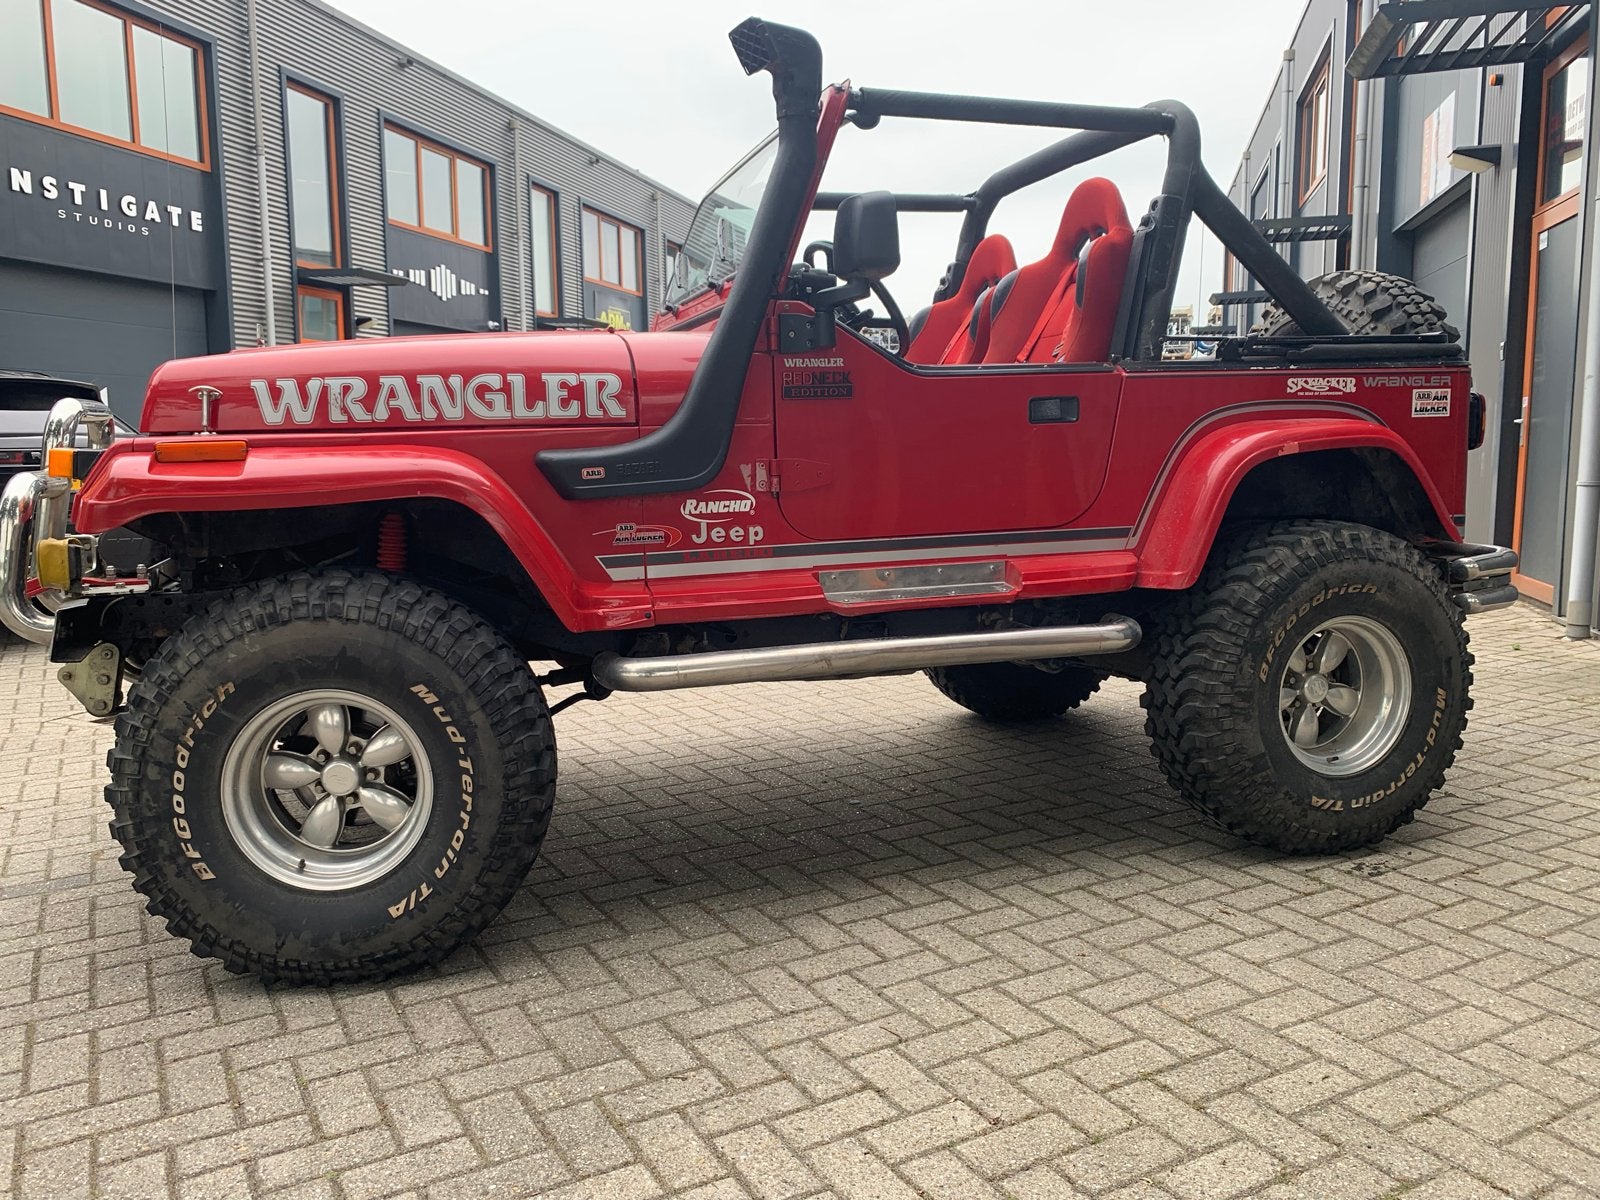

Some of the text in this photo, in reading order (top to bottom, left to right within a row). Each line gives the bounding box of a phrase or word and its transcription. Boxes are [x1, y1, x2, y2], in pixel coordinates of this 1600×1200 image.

[58, 208, 150, 236] STUDIOS
[783, 357, 845, 368] WRANGLER
[782, 371, 852, 385] REDNECK
[1286, 377, 1357, 393] SKYJACKER
[250, 373, 627, 425] WRANGLER
[791, 387, 848, 397] EDITION
[1416, 391, 1449, 401] ARB AIR
[1414, 402, 1449, 412] LOCKER
[584, 468, 603, 478] ARB
[683, 498, 752, 515] RANCHO
[614, 531, 665, 543] AIR LOCKER
[691, 522, 764, 545] Jeep
[1257, 582, 1378, 683] BFGoodrich
[1311, 687, 1447, 811] Mud-Terrain T/A
[172, 680, 237, 881] BFGoodrich
[387, 683, 475, 919] Mud-Terrain T/A
